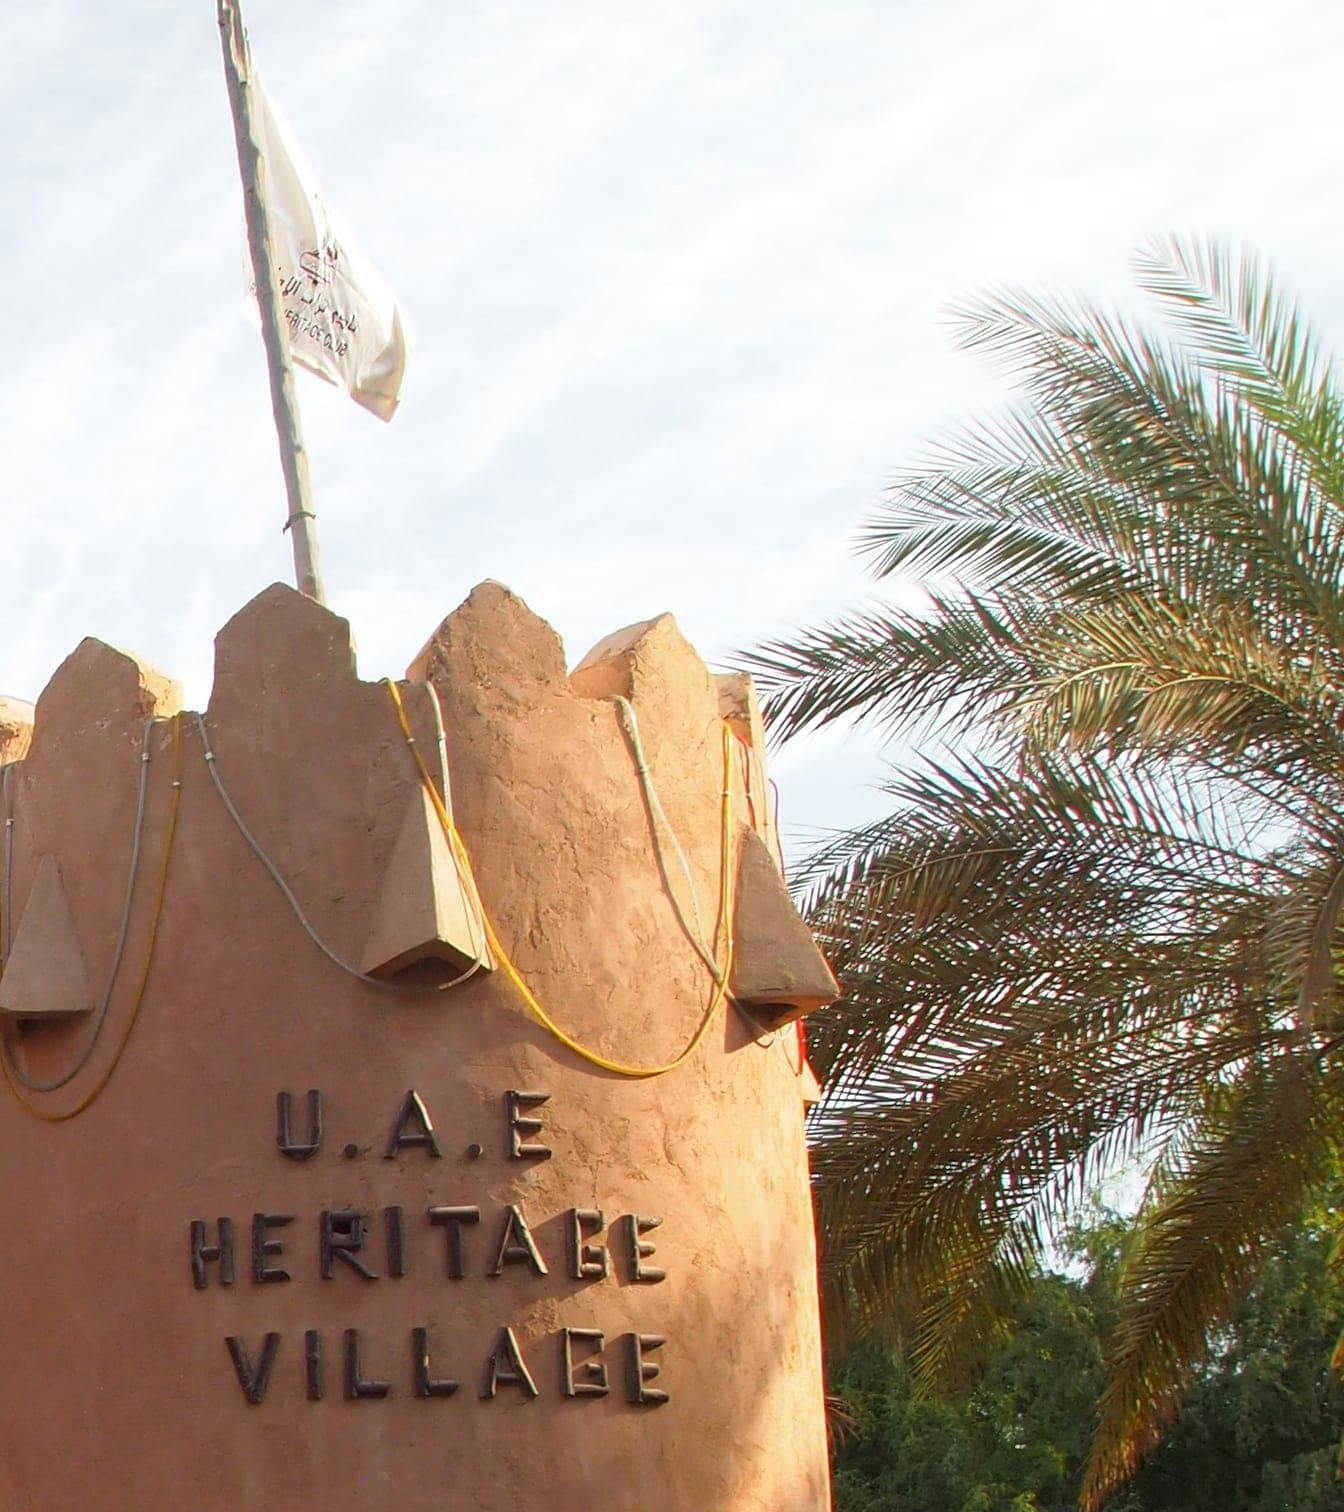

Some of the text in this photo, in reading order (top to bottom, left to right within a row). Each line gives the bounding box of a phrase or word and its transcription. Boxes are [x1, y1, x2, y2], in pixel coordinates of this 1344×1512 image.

[276, 1088, 554, 1162] U.A.E
[189, 1204, 668, 1290] HERITAGE
[224, 1326, 672, 1406] VILLAGE
